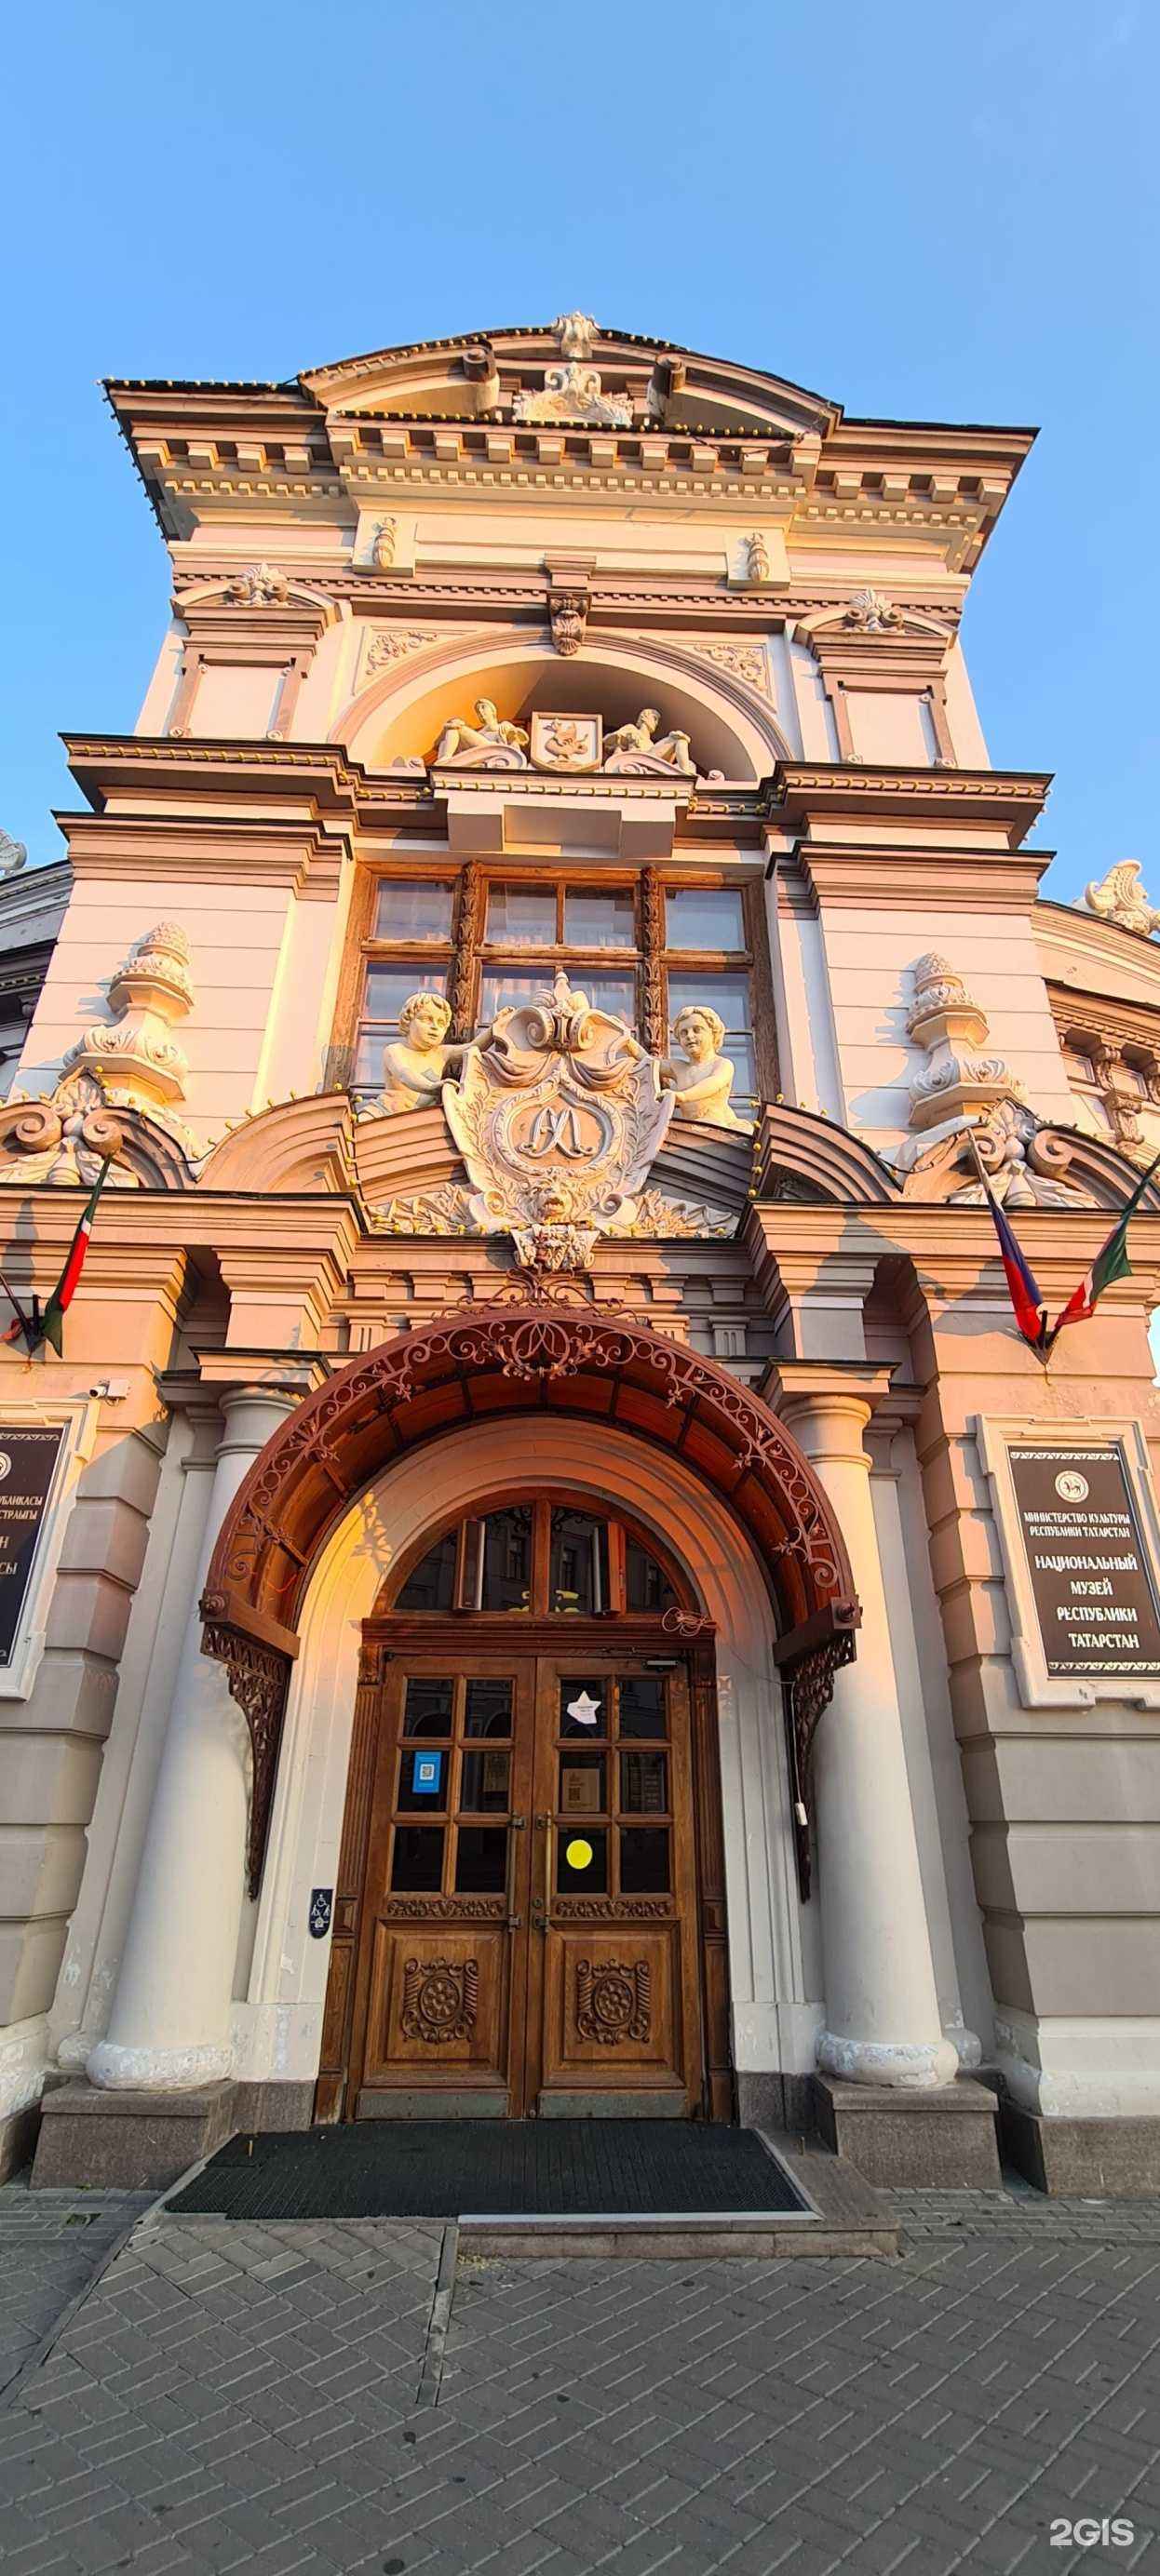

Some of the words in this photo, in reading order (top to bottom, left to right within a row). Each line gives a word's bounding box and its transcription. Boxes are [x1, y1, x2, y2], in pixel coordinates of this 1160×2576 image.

[1023, 1512, 1087, 1523] МИНИСТЕРСТВО
[1088, 1513, 1130, 1524] КУЛЬТУРЫ
[1029, 1525, 1083, 1536] РЕСПУБЛИКИ
[1083, 1526, 1130, 1538] ТАТАРСТАН
[1034, 1552, 1138, 1572] НАЦИОНАЛЬНЫЙ
[1070, 1576, 1113, 1595] МУЗЕЙ
[1057, 1606, 1138, 1622] РЕСПУБЛИКИ
[1068, 1632, 1140, 1648] ТАТАРСТАН
